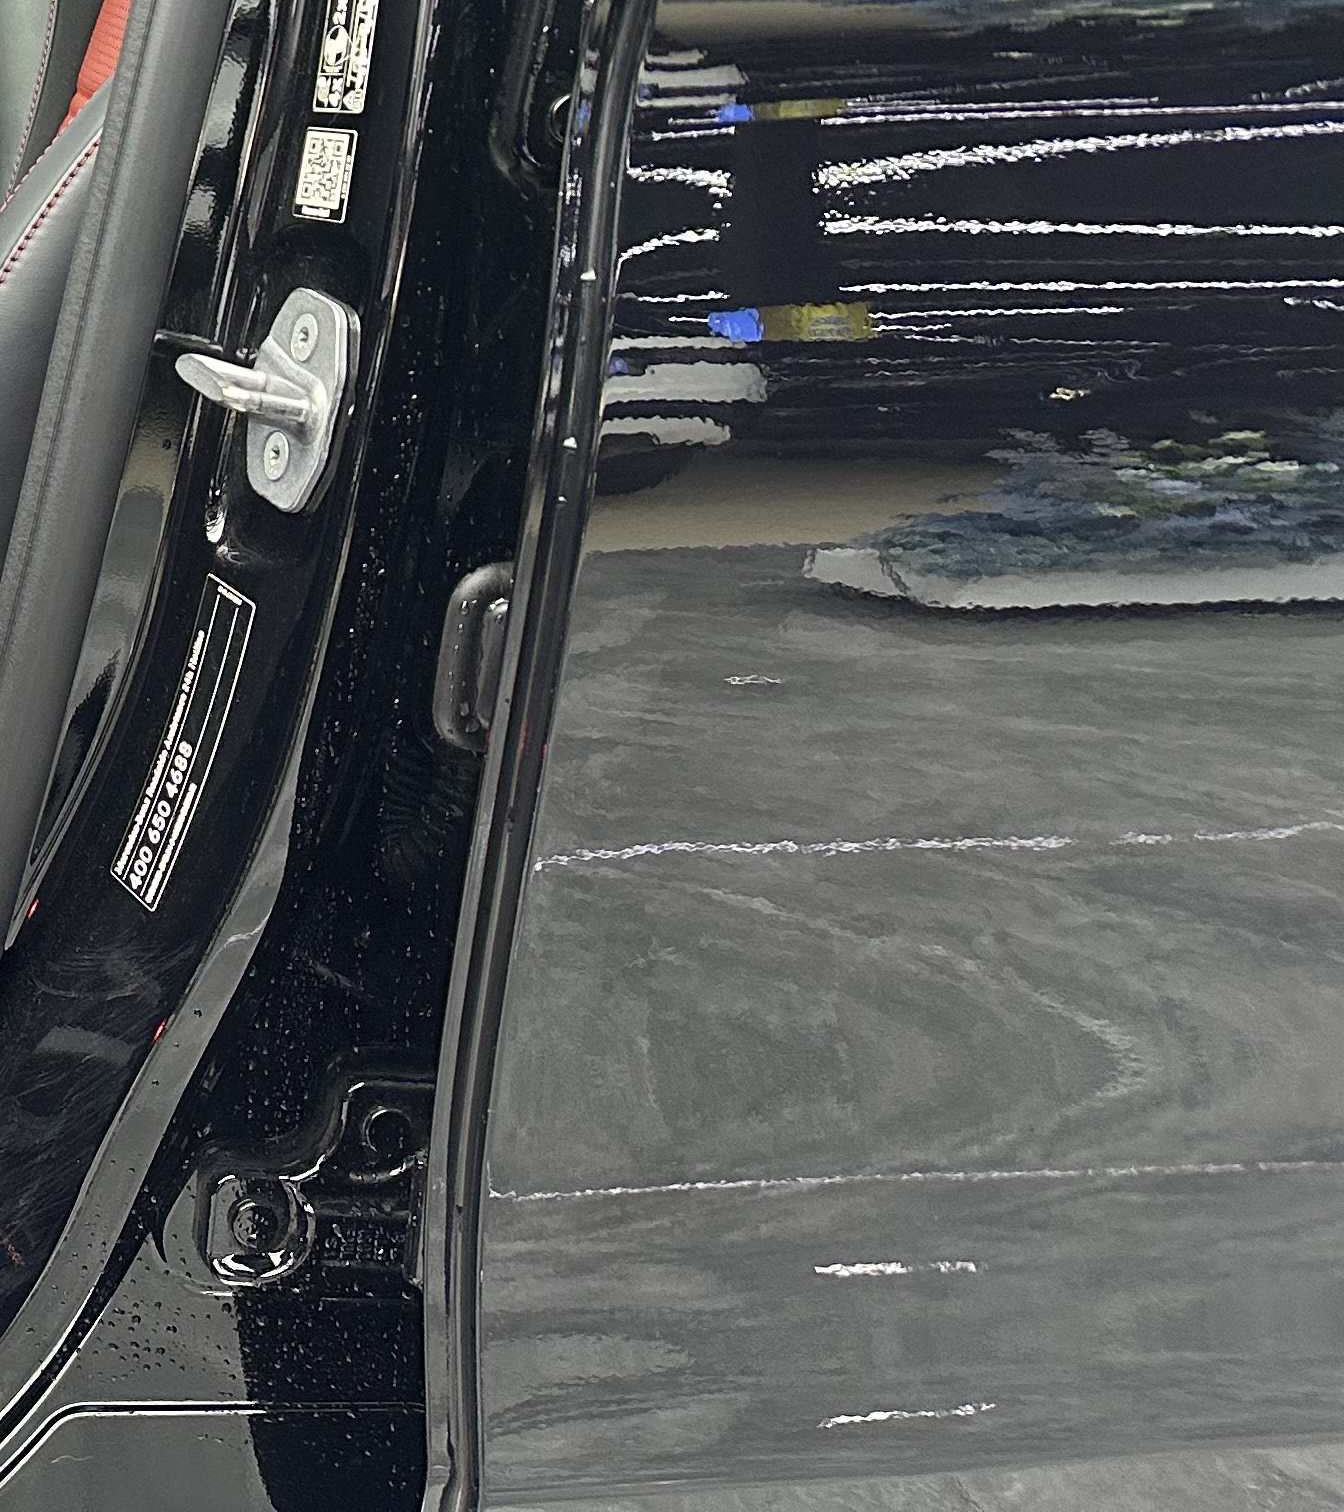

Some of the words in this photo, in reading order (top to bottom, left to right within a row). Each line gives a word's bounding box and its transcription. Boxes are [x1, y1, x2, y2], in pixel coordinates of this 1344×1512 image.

[128, 845, 153, 889] 400
[147, 800, 171, 844] 650
[165, 740, 193, 799] 4688
